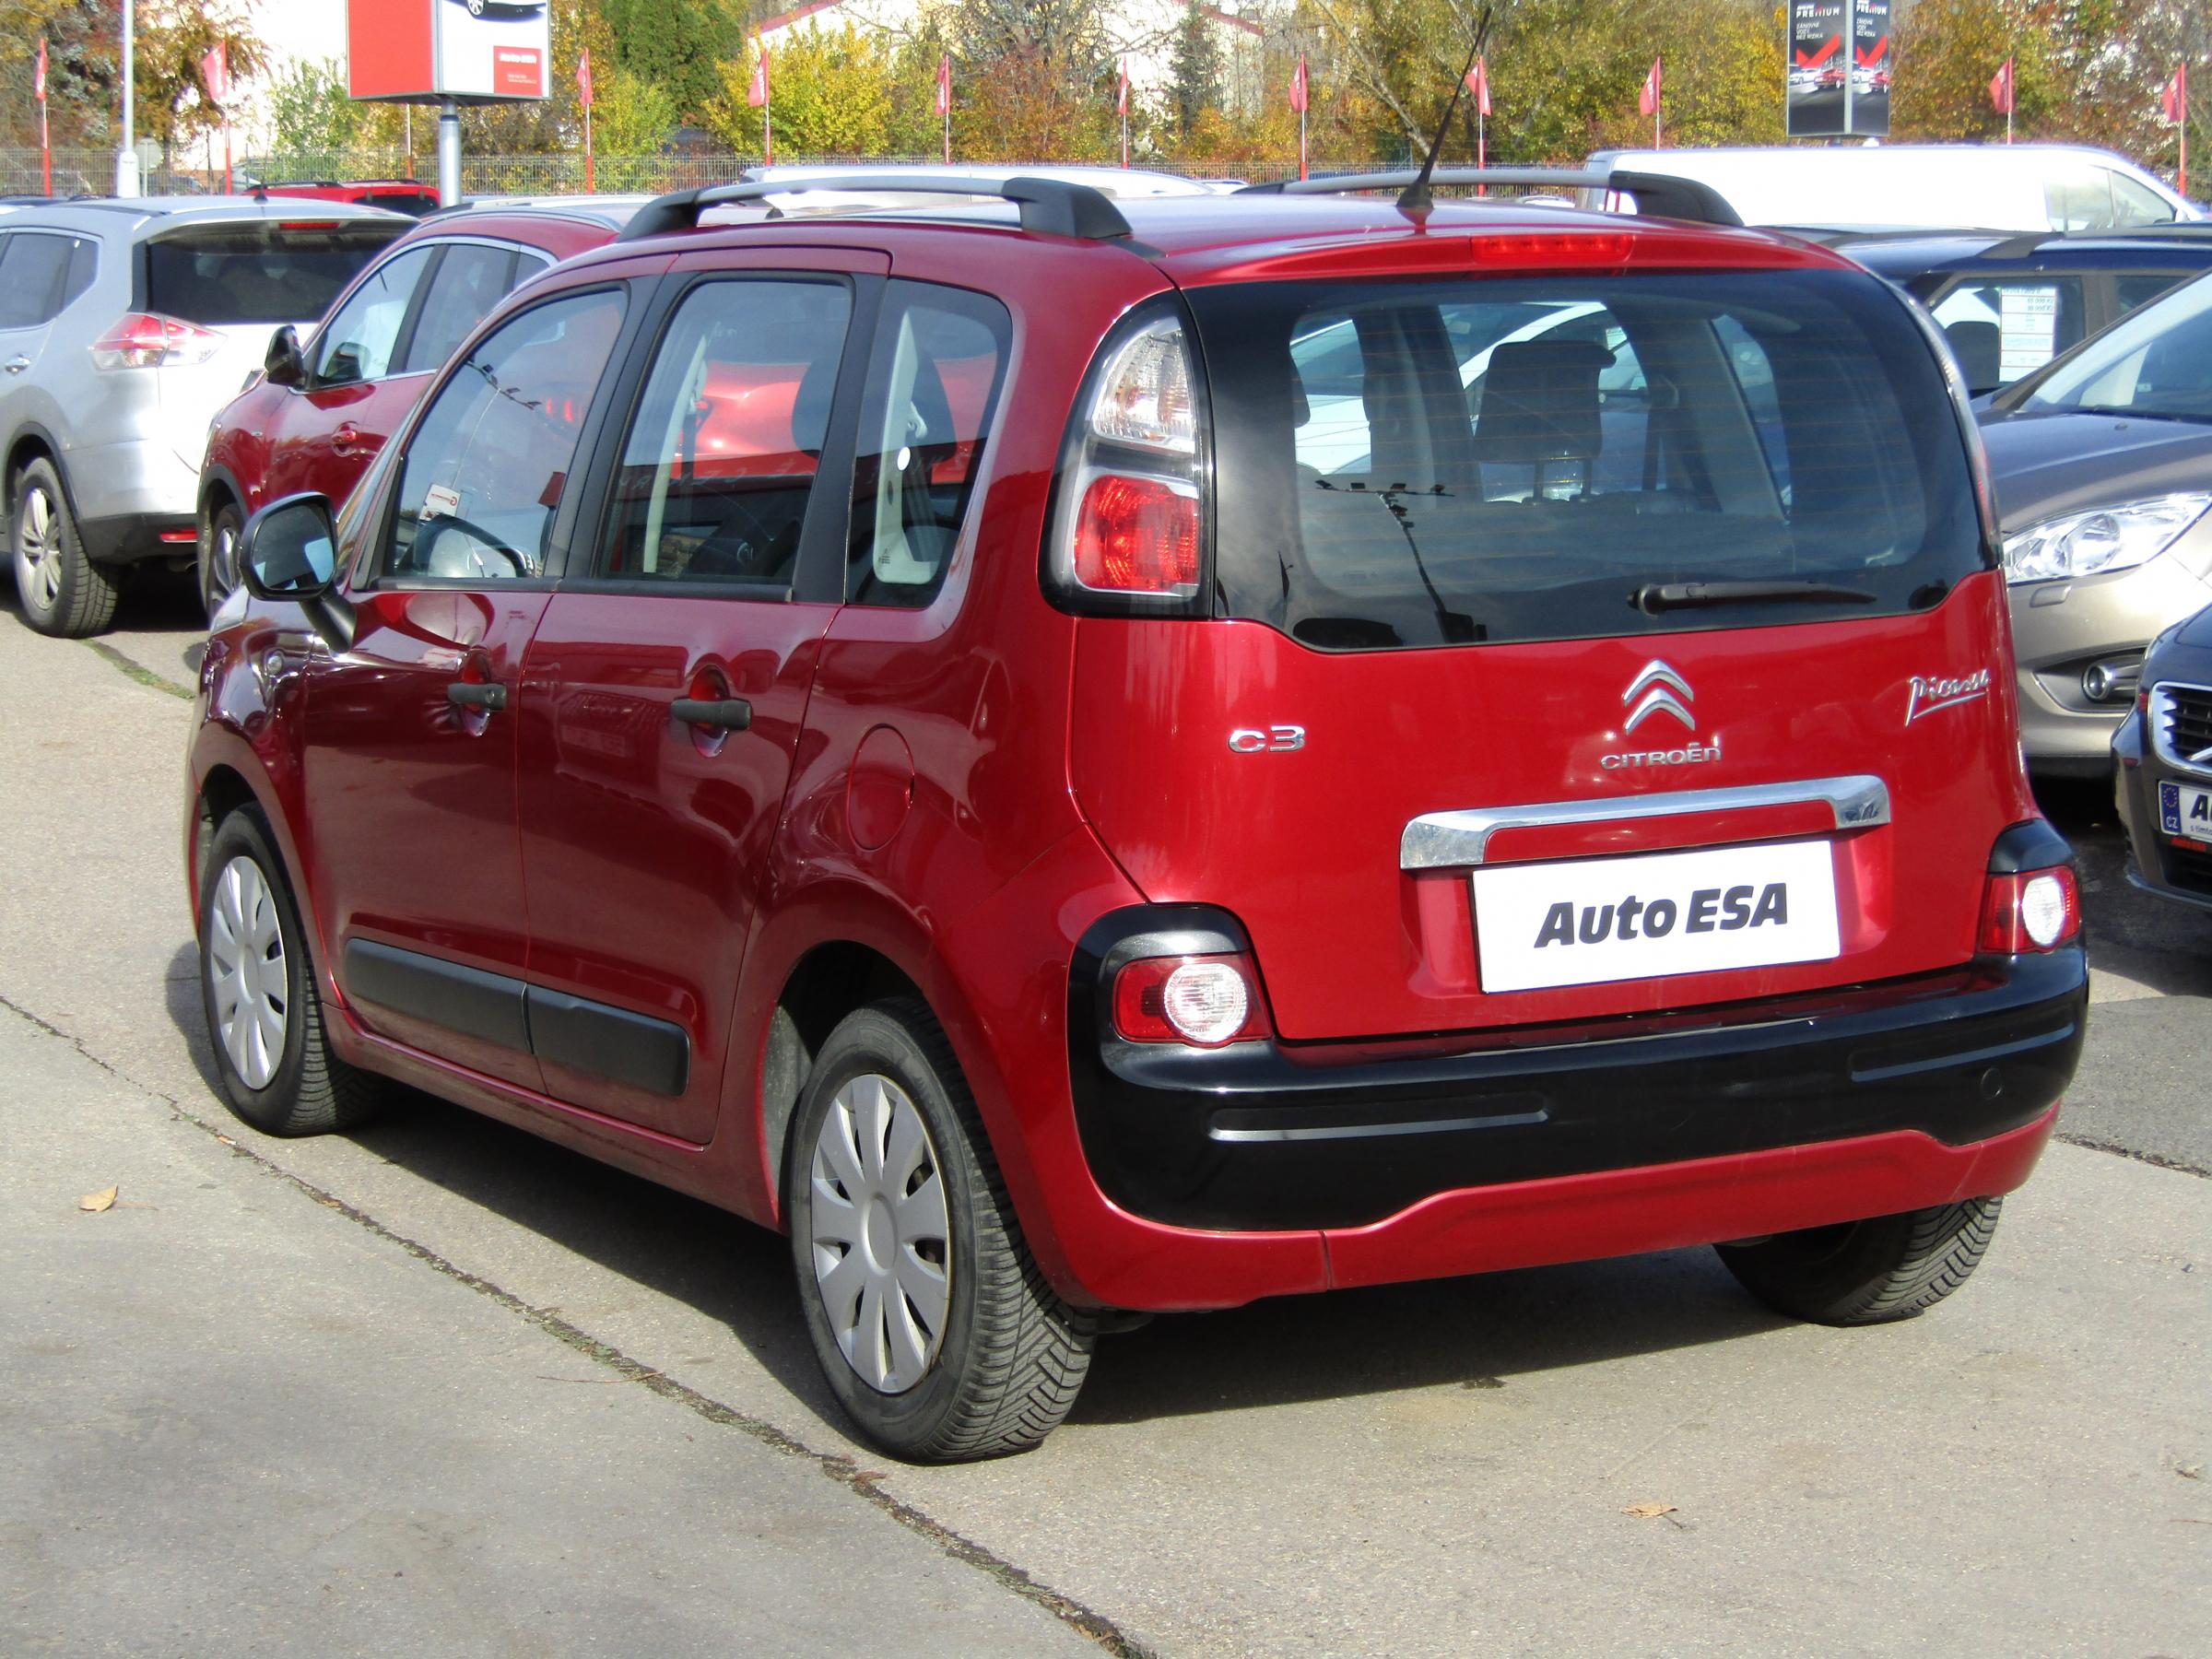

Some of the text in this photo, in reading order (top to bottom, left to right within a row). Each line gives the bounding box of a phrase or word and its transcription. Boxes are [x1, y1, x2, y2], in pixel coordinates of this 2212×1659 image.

[1229, 724, 1306, 753] C3
[2189, 794, 2212, 822] A
[2166, 816, 2179, 830] CZ
[1534, 882, 1788, 948] Auto ESA
